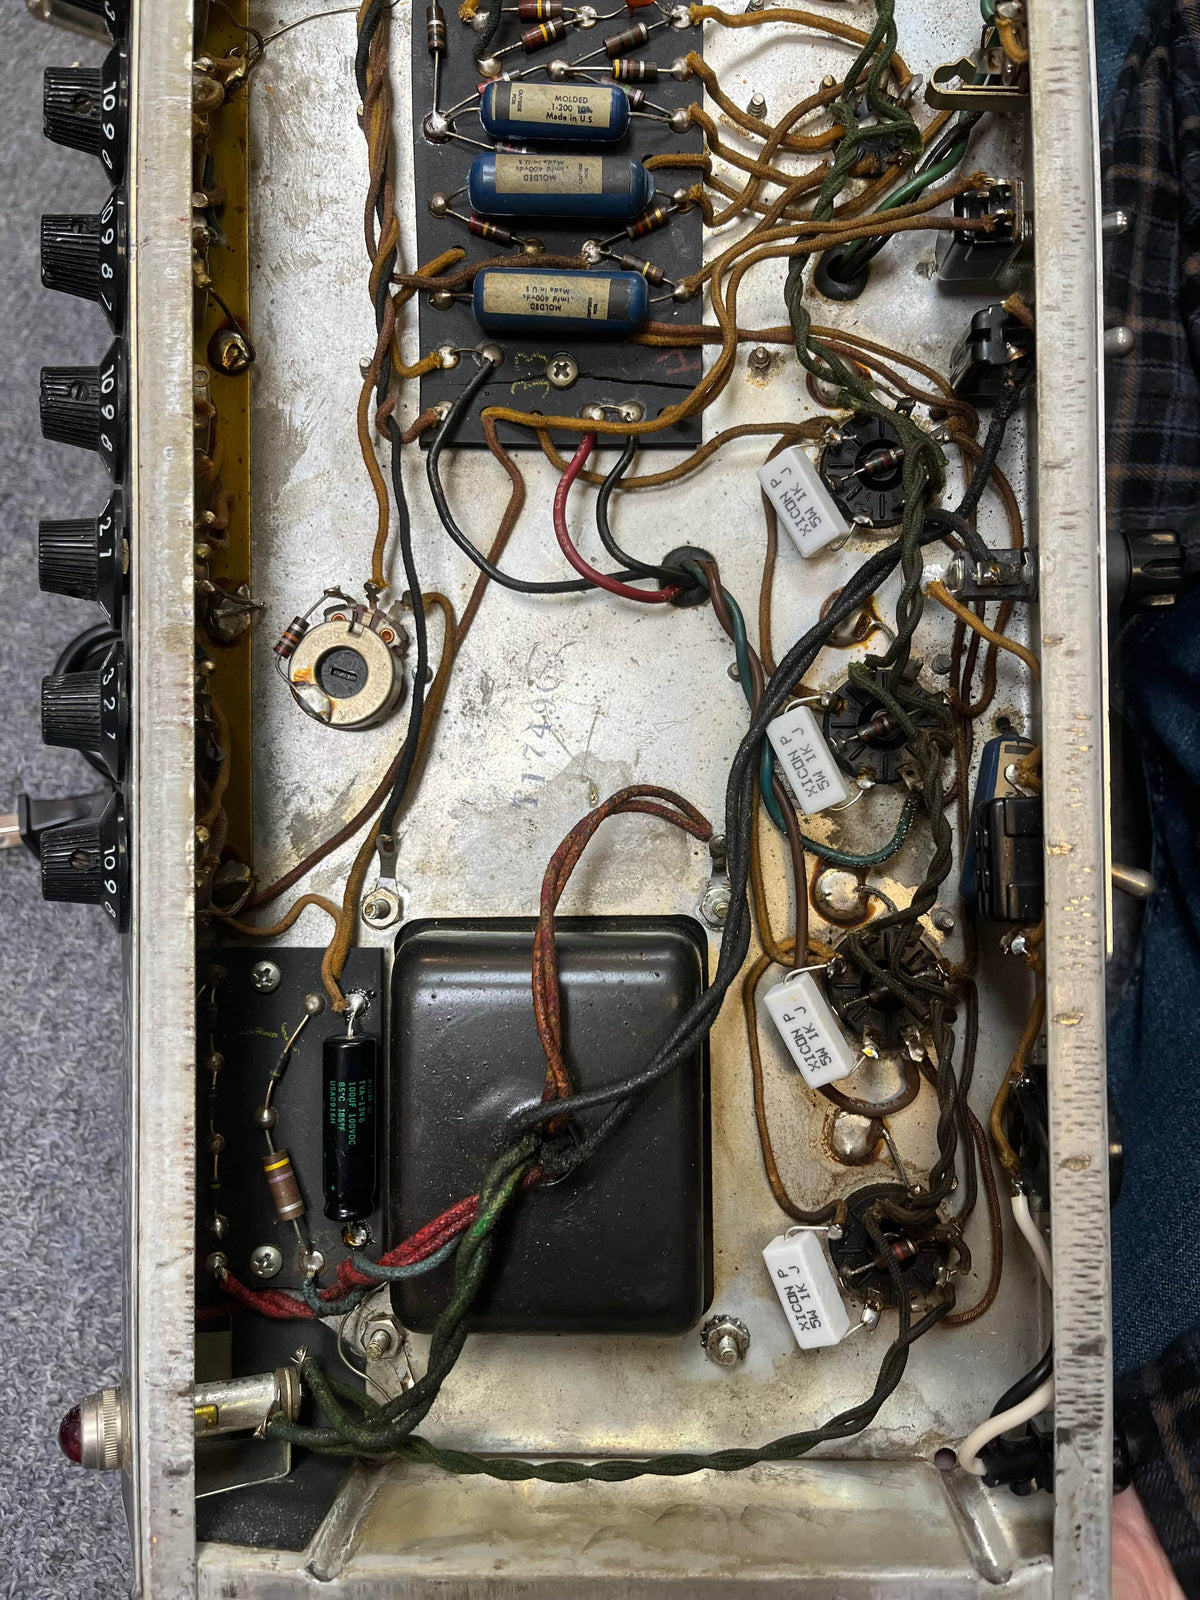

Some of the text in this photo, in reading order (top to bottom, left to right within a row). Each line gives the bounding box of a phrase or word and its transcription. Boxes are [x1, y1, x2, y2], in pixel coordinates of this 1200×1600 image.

[103, 81, 116, 111] 10
[548, 104, 573, 112] .1-200
[555, 95, 588, 104] MOLDED
[103, 123, 114, 140] 9
[546, 112, 567, 121] Made
[570, 114, 577, 122] in
[523, 174, 557, 182] MOLDED
[101, 196, 114, 224] 10
[101, 228, 114, 244] 9
[101, 263, 114, 279] 8
[530, 303, 562, 312] MOLDED
[101, 364, 114, 394] 10
[101, 404, 114, 420] 9
[101, 433, 113, 452] 8
[554, 473, 568, 508] CABLE
[780, 466, 822, 528] 5W 1K J
[770, 478, 812, 537] XICON P
[100, 516, 112, 536] 2
[100, 548, 112, 557] 1
[103, 667, 116, 740] 3 2 1
[780, 736, 818, 797] XICON P
[791, 727, 830, 791] 5W 1K J
[104, 845, 117, 918] 10 9 8
[783, 1013, 821, 1072] XICON P
[794, 1006, 832, 1067] 5W 1K J
[348, 1082, 357, 1145] 100UF 100VDC
[358, 1080, 366, 1123] TVA-1346
[777, 1269, 811, 1331] XICON P
[788, 1265, 821, 1329] 5W 1K J
